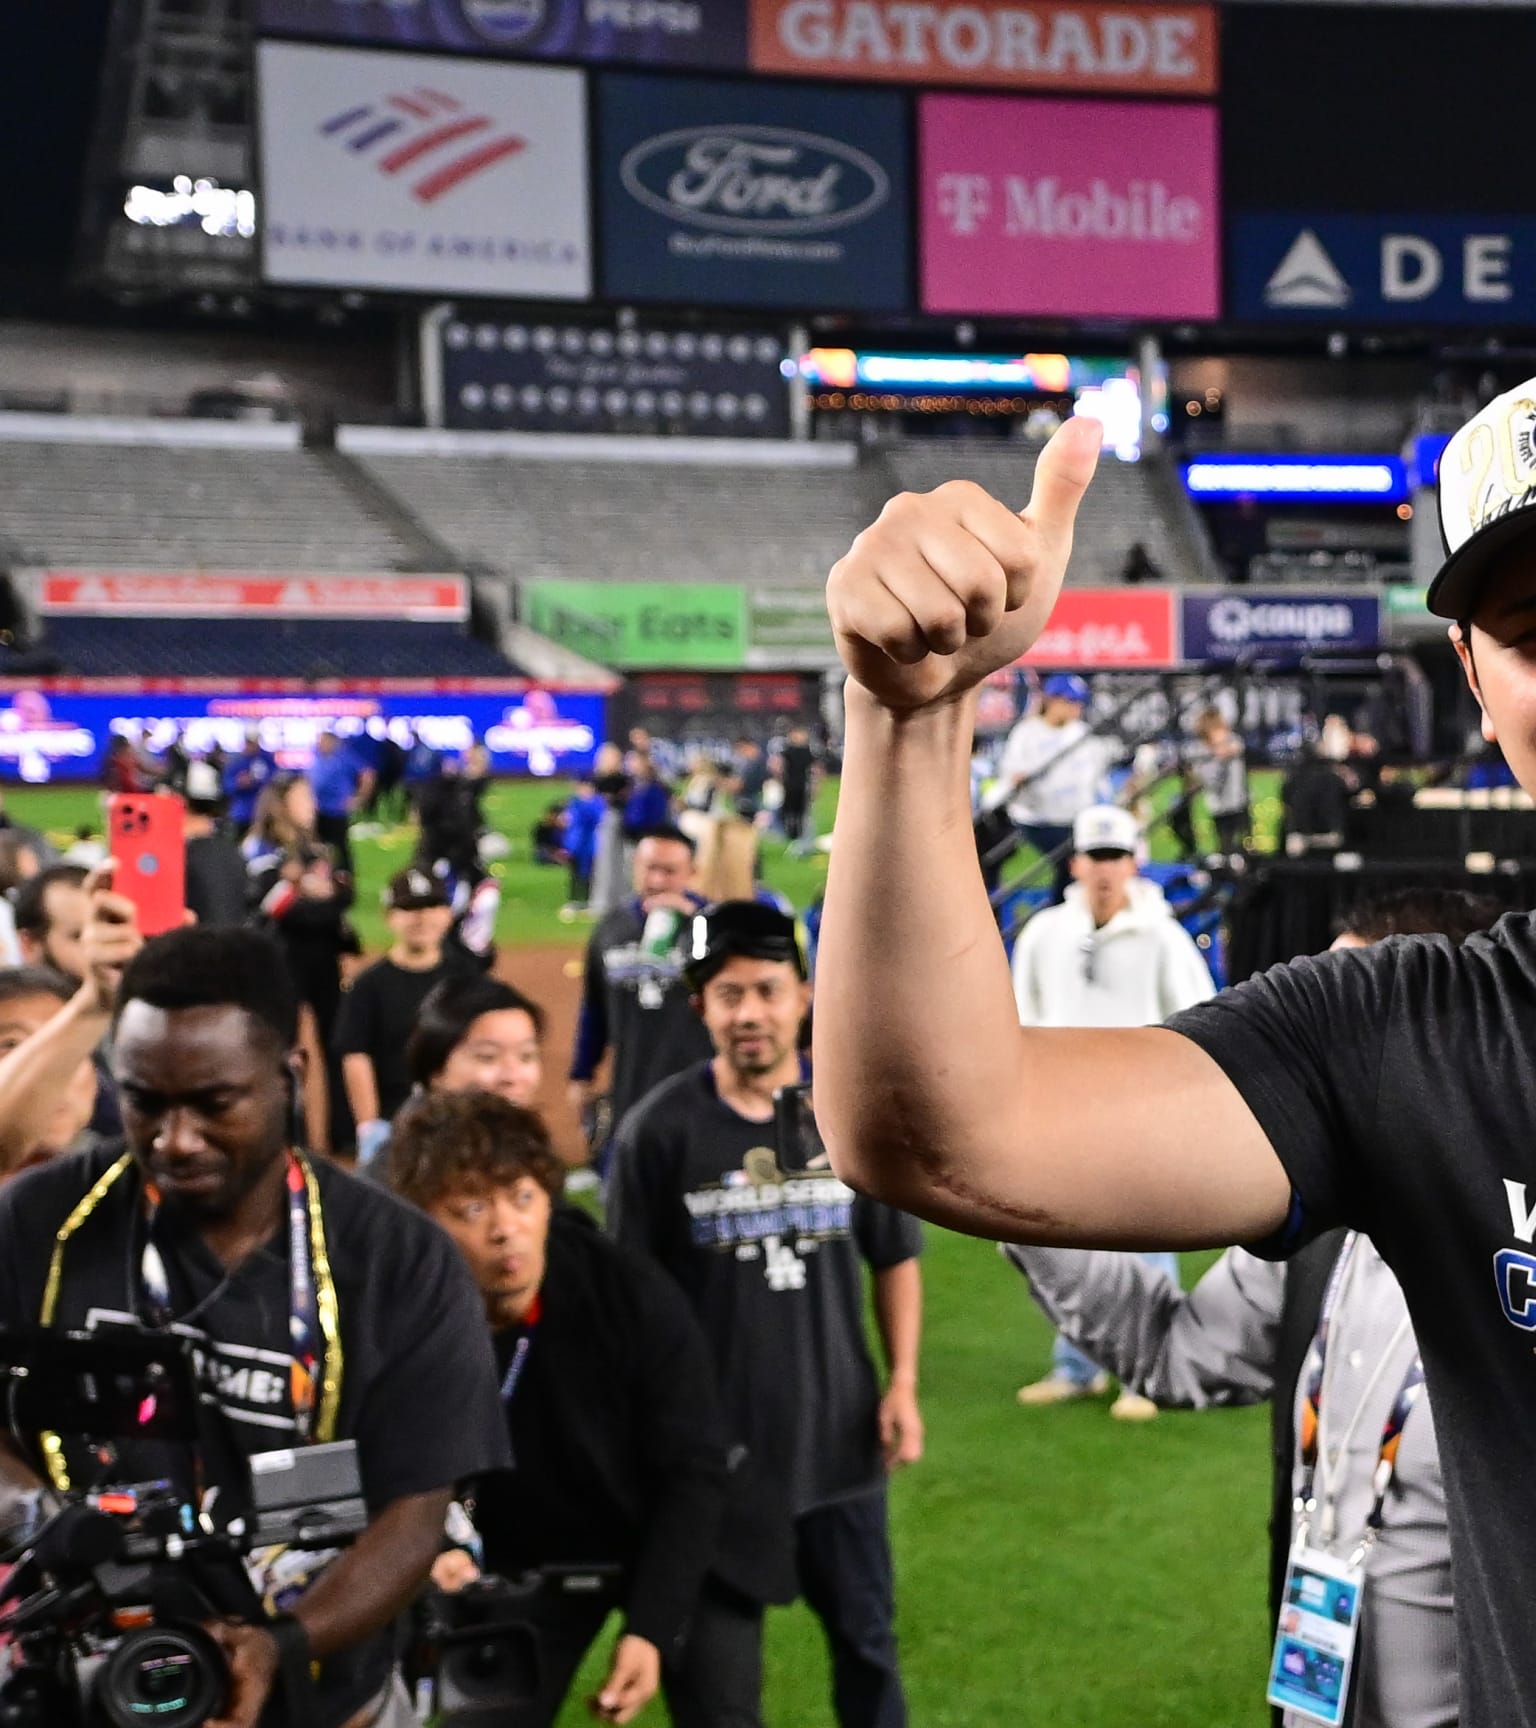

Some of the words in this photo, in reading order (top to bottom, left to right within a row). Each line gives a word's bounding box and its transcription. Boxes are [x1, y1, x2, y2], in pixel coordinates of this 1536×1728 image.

[778, 2, 1197, 78] GATORADE
[667, 136, 842, 216] Ford
[1002, 177, 1200, 241] Mobile
[1261, 603, 1355, 643] coupa
[683, 1184, 783, 1218] WORLD
[763, 1235, 807, 1291] LA
